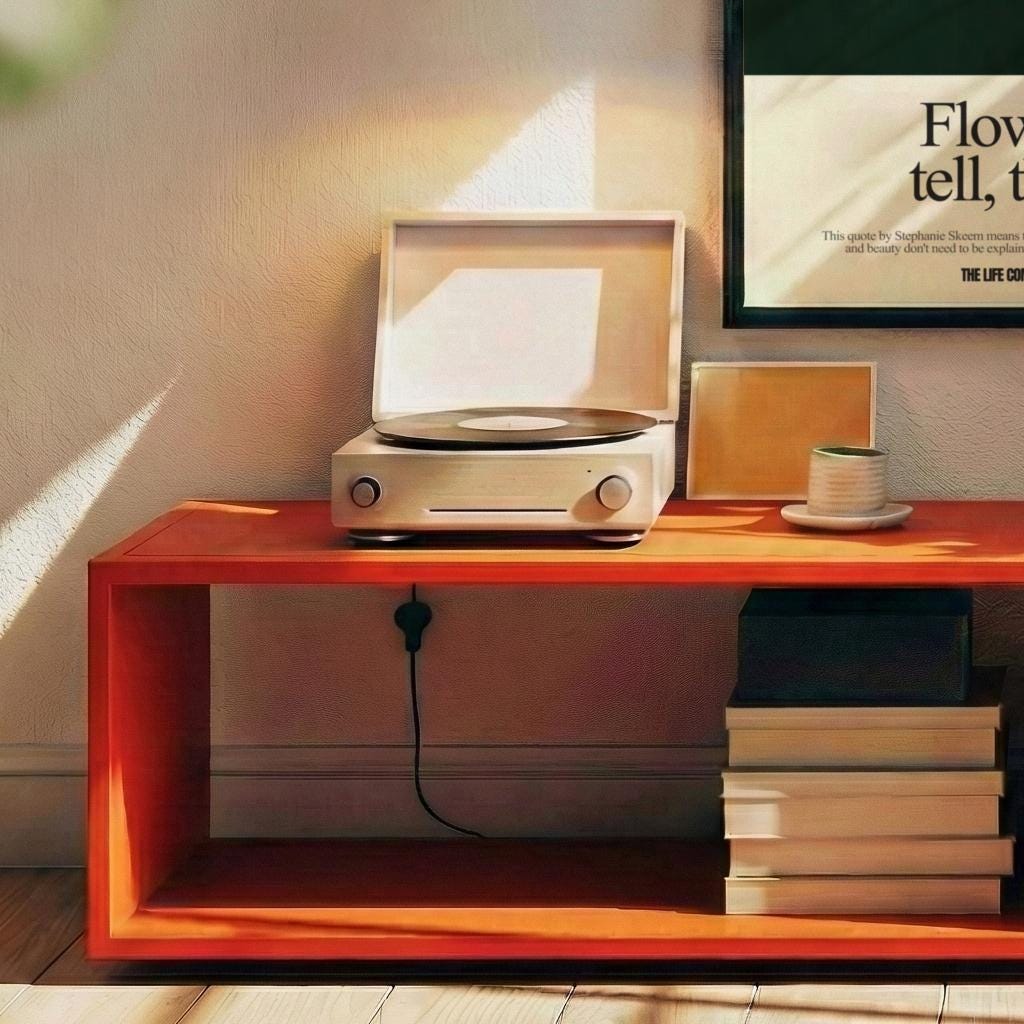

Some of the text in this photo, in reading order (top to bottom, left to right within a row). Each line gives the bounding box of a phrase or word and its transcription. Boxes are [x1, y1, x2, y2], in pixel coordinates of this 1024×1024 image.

[909, 155, 995, 211] tell,
[822, 230, 845, 241] This
[847, 232, 876, 243] quote
[878, 230, 892, 243] by
[894, 230, 946, 243] Stephanie
[948, 230, 983, 241] Skeem
[986, 232, 1020, 241] means
[844, 243, 864, 254] and
[866, 243, 901, 256] beauty
[903, 243, 929, 254] don't
[931, 243, 956, 254] need
[959, 244, 969, 254] to
[971, 243, 984, 254] be
[961, 267, 981, 282] THE
[983, 267, 1004, 282] LIFE
